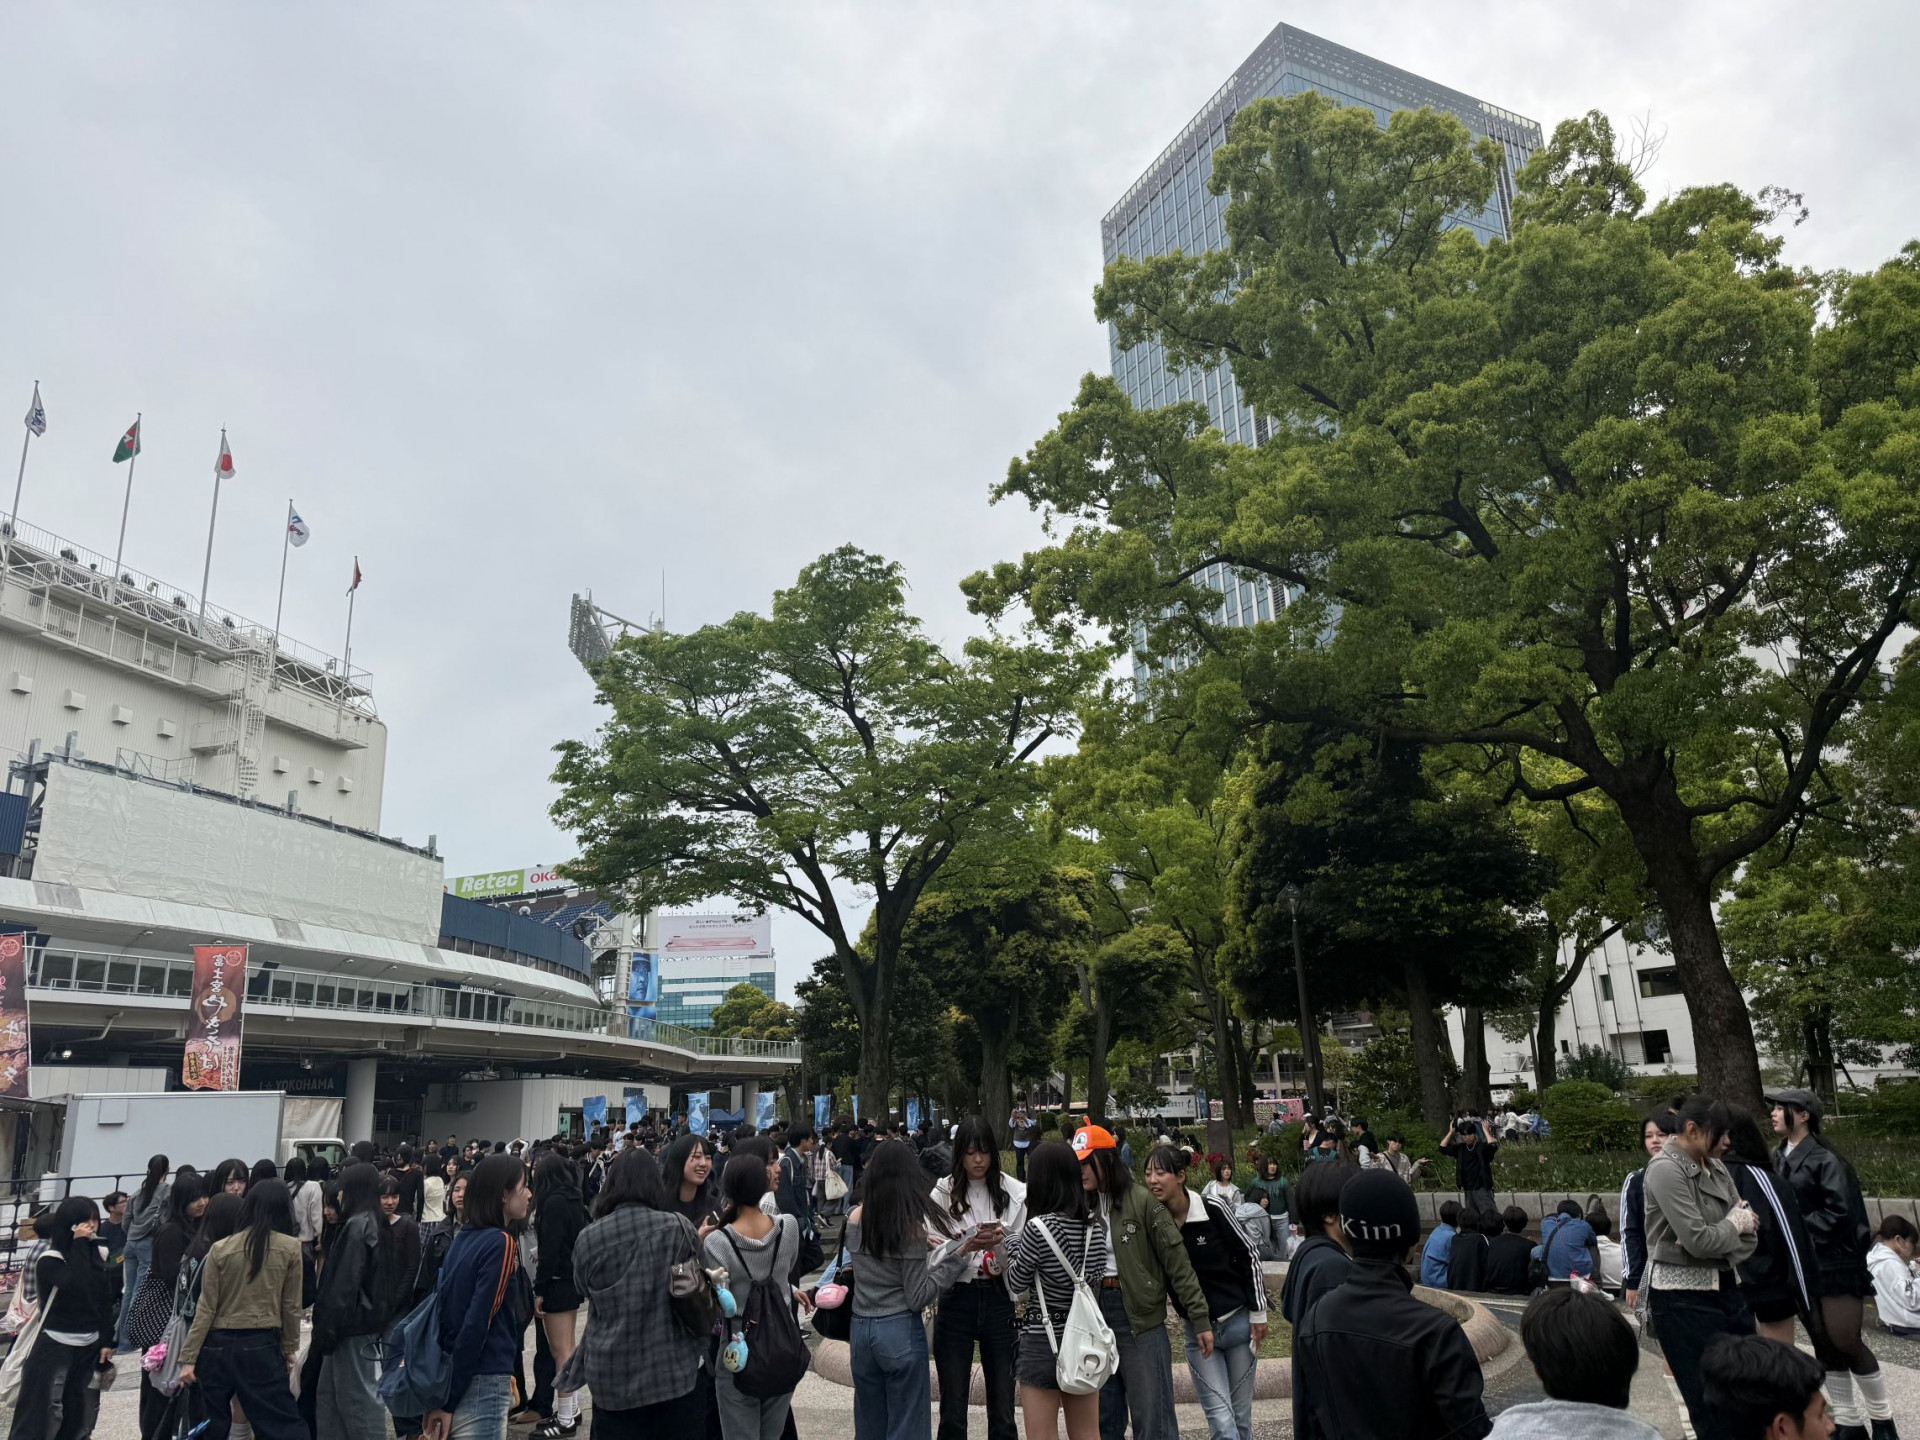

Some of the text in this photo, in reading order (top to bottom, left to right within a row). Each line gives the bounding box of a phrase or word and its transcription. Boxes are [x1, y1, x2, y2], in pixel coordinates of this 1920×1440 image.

[461, 873, 518, 892] Retec
[276, 1078, 334, 1091] YOKOHAMA
[1340, 1213, 1401, 1240] Kim
